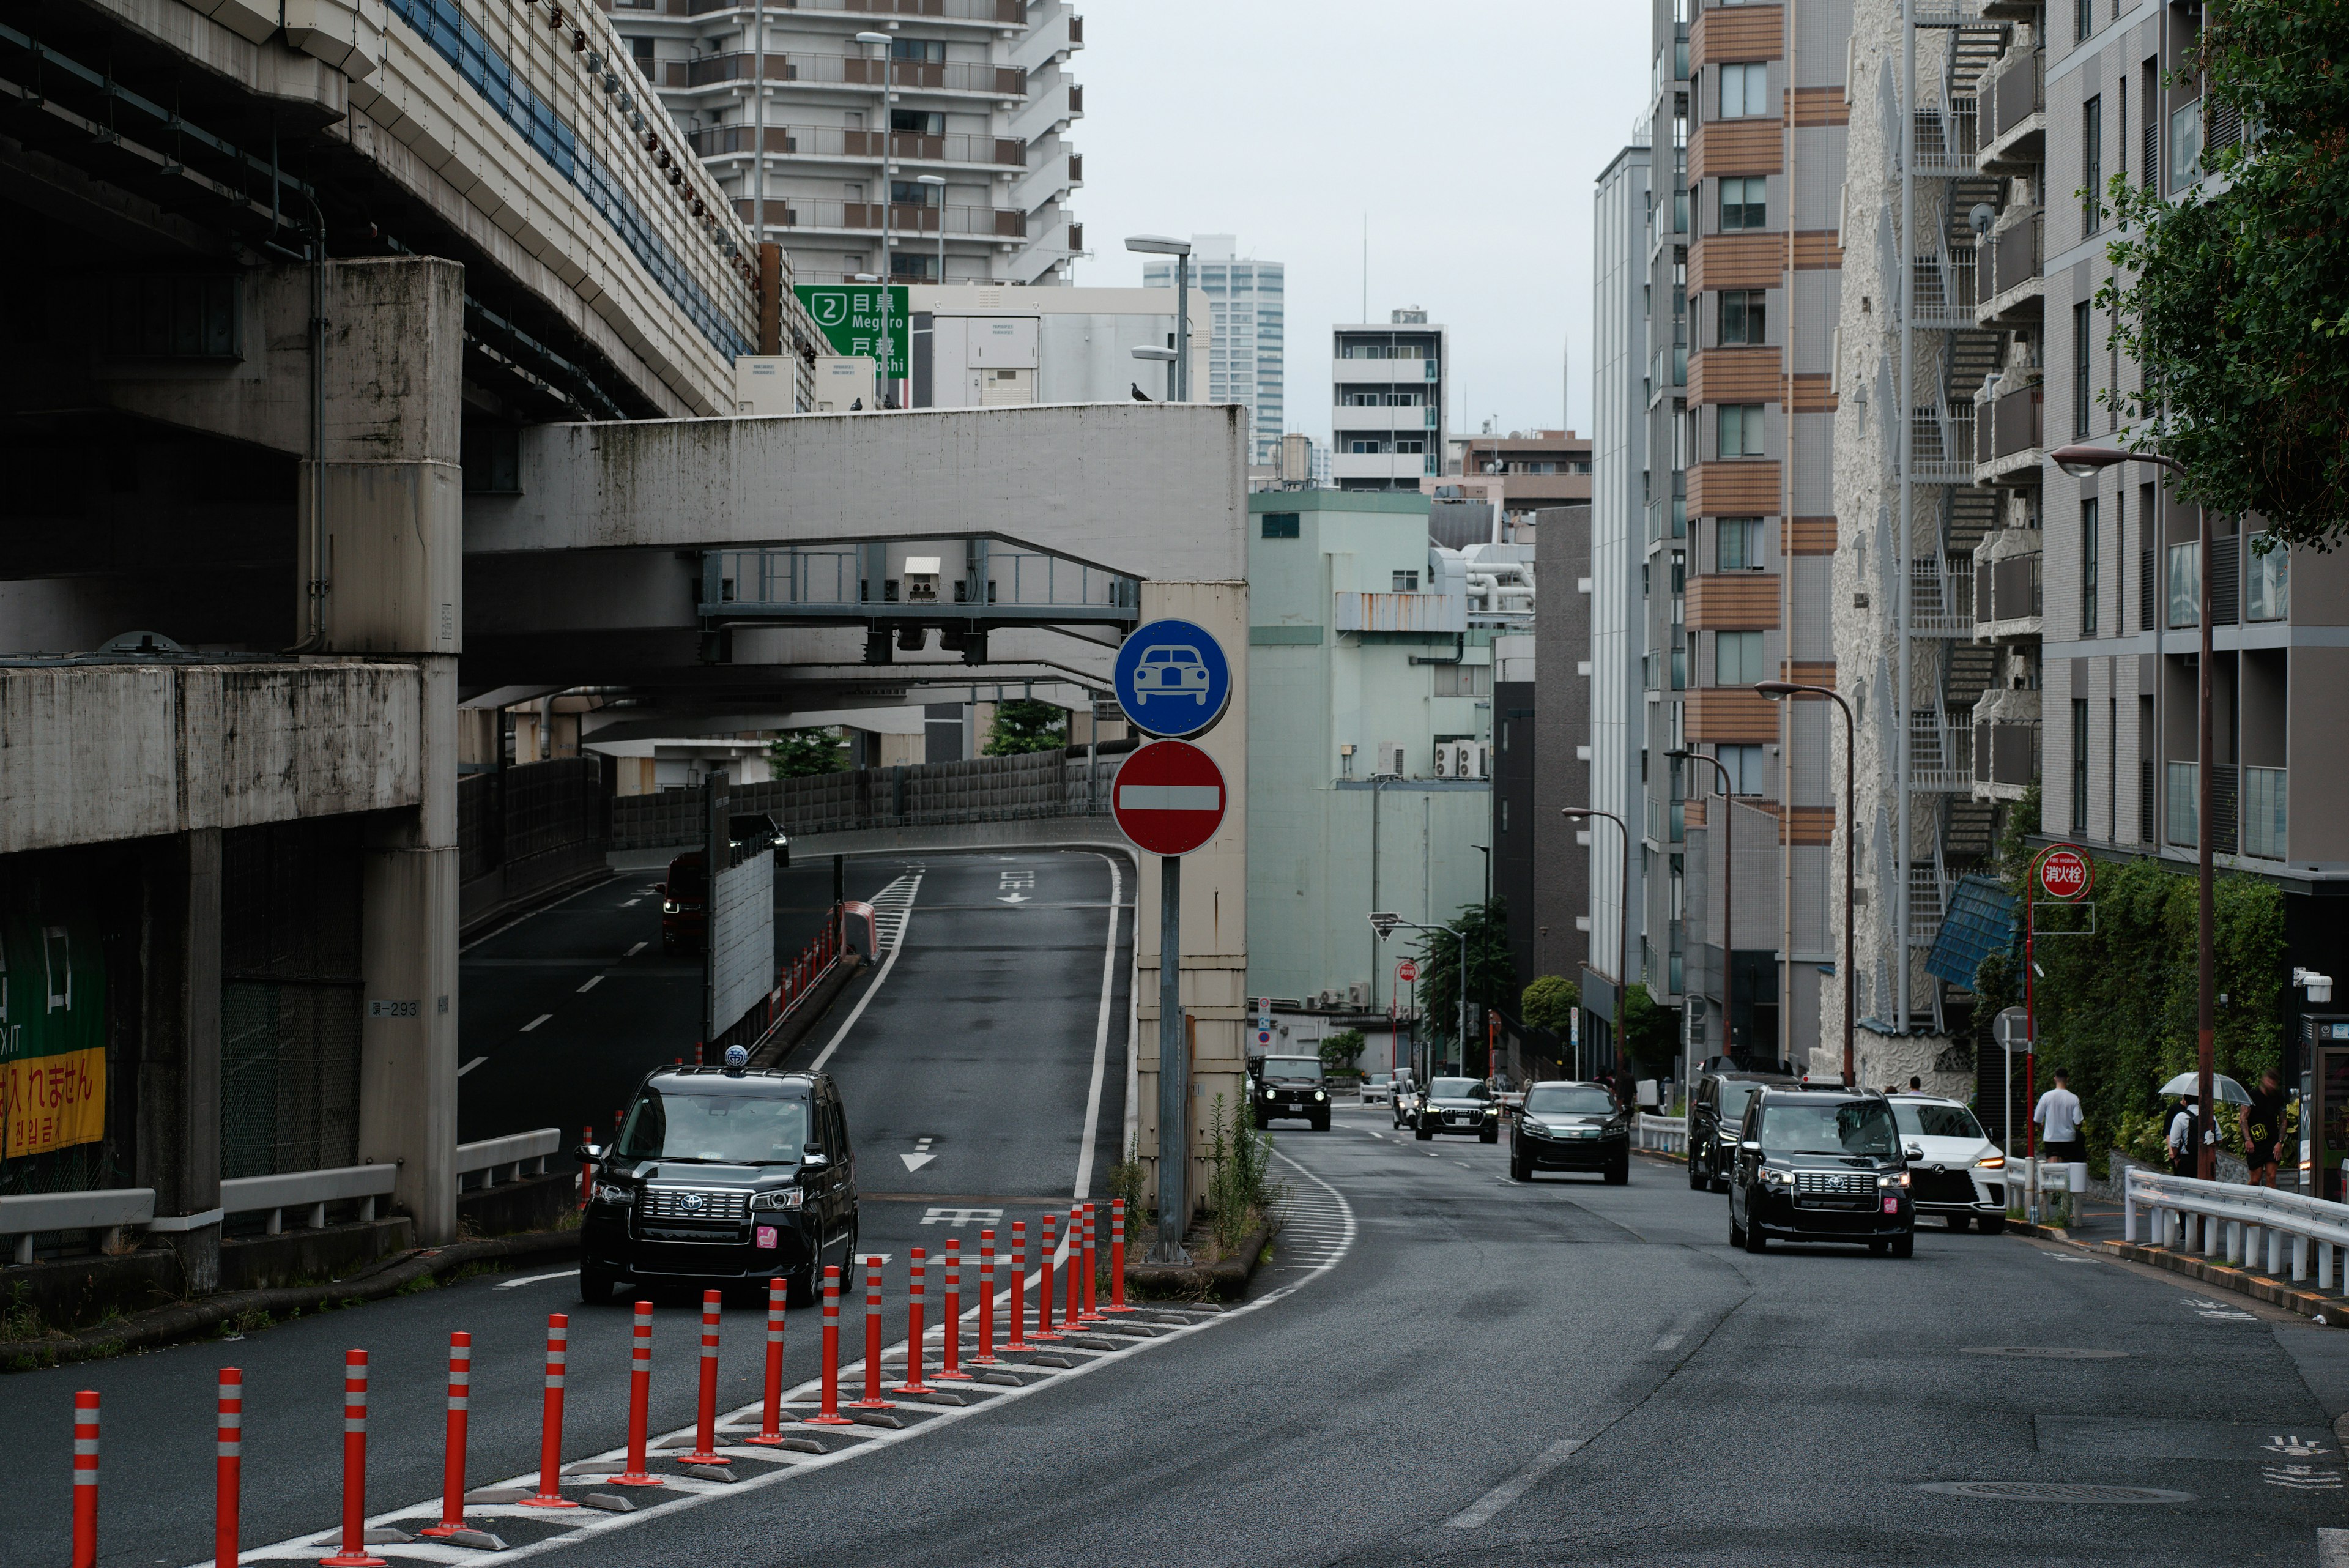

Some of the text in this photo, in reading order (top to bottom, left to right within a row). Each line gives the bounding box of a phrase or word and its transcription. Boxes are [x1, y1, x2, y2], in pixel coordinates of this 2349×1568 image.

[823, 299, 836, 318] 2
[853, 294, 894, 313] 目黒
[852, 315, 903, 331] Megro
[852, 337, 894, 356] 戸越
[2046, 866, 2082, 883] 消火栓
